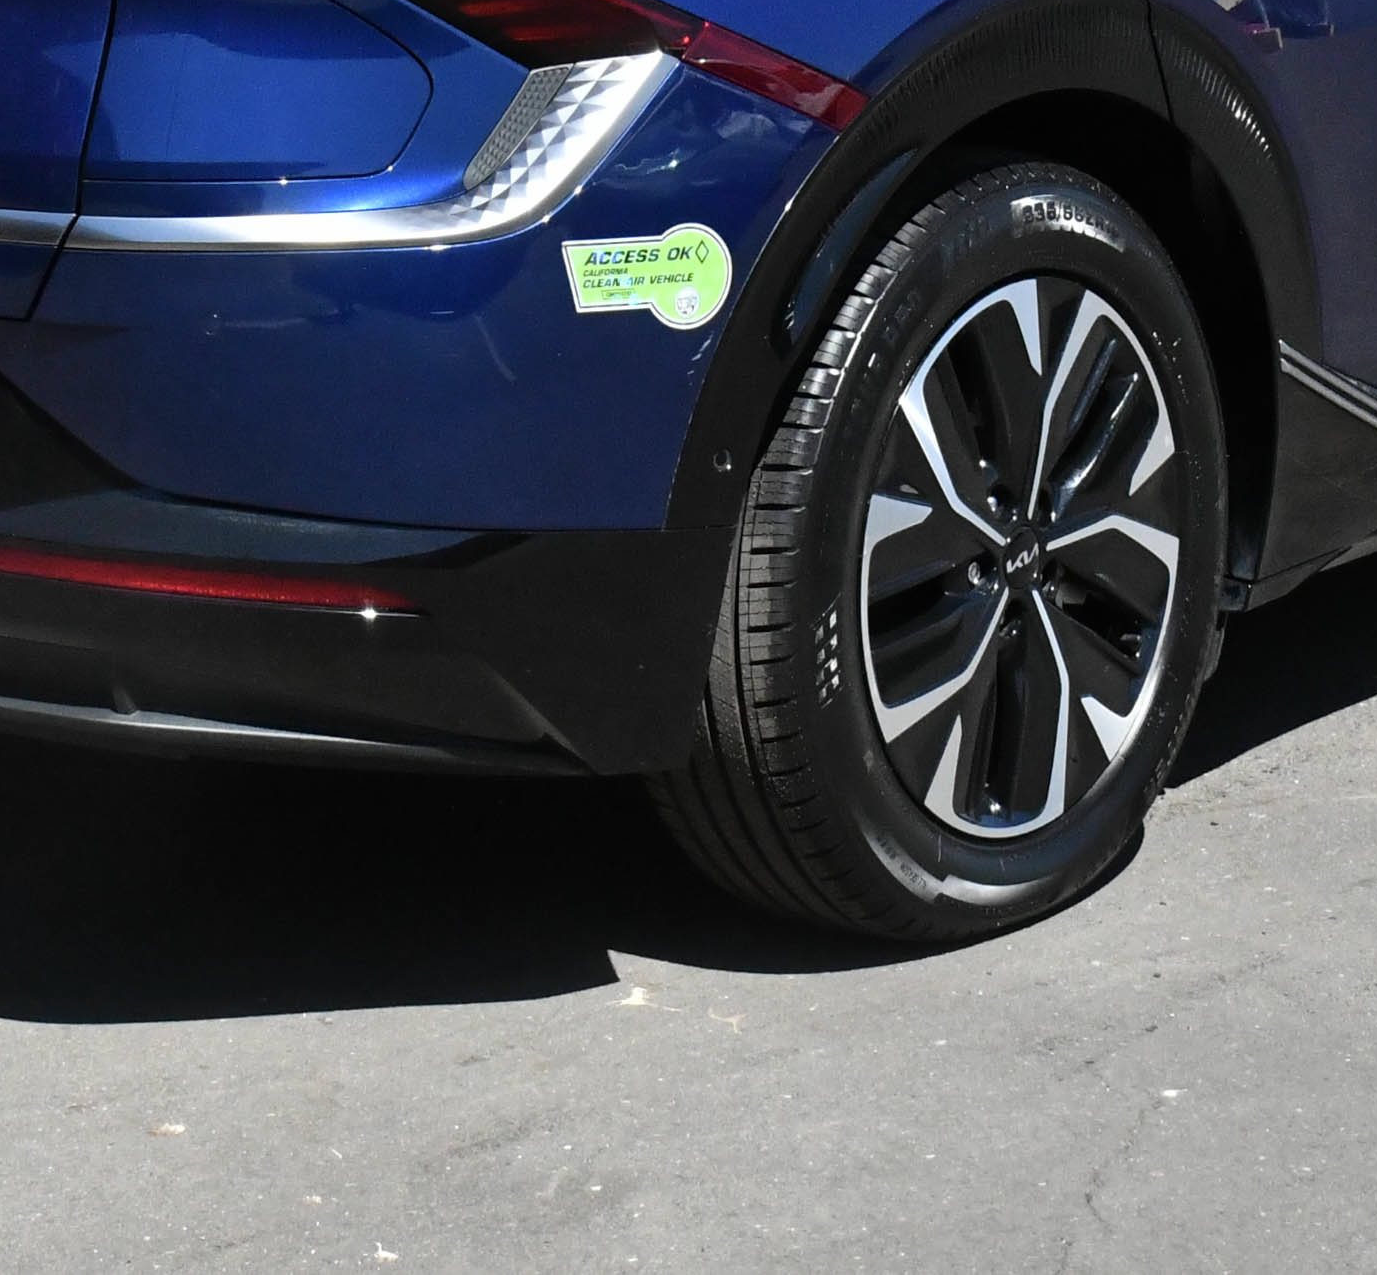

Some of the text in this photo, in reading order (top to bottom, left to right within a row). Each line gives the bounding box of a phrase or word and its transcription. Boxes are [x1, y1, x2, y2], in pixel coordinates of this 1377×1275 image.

[584, 245, 694, 267] ACCESS OK
[582, 267, 629, 278] CALIFORNIA
[582, 273, 694, 289] CLEAN AIR VEHICLE
